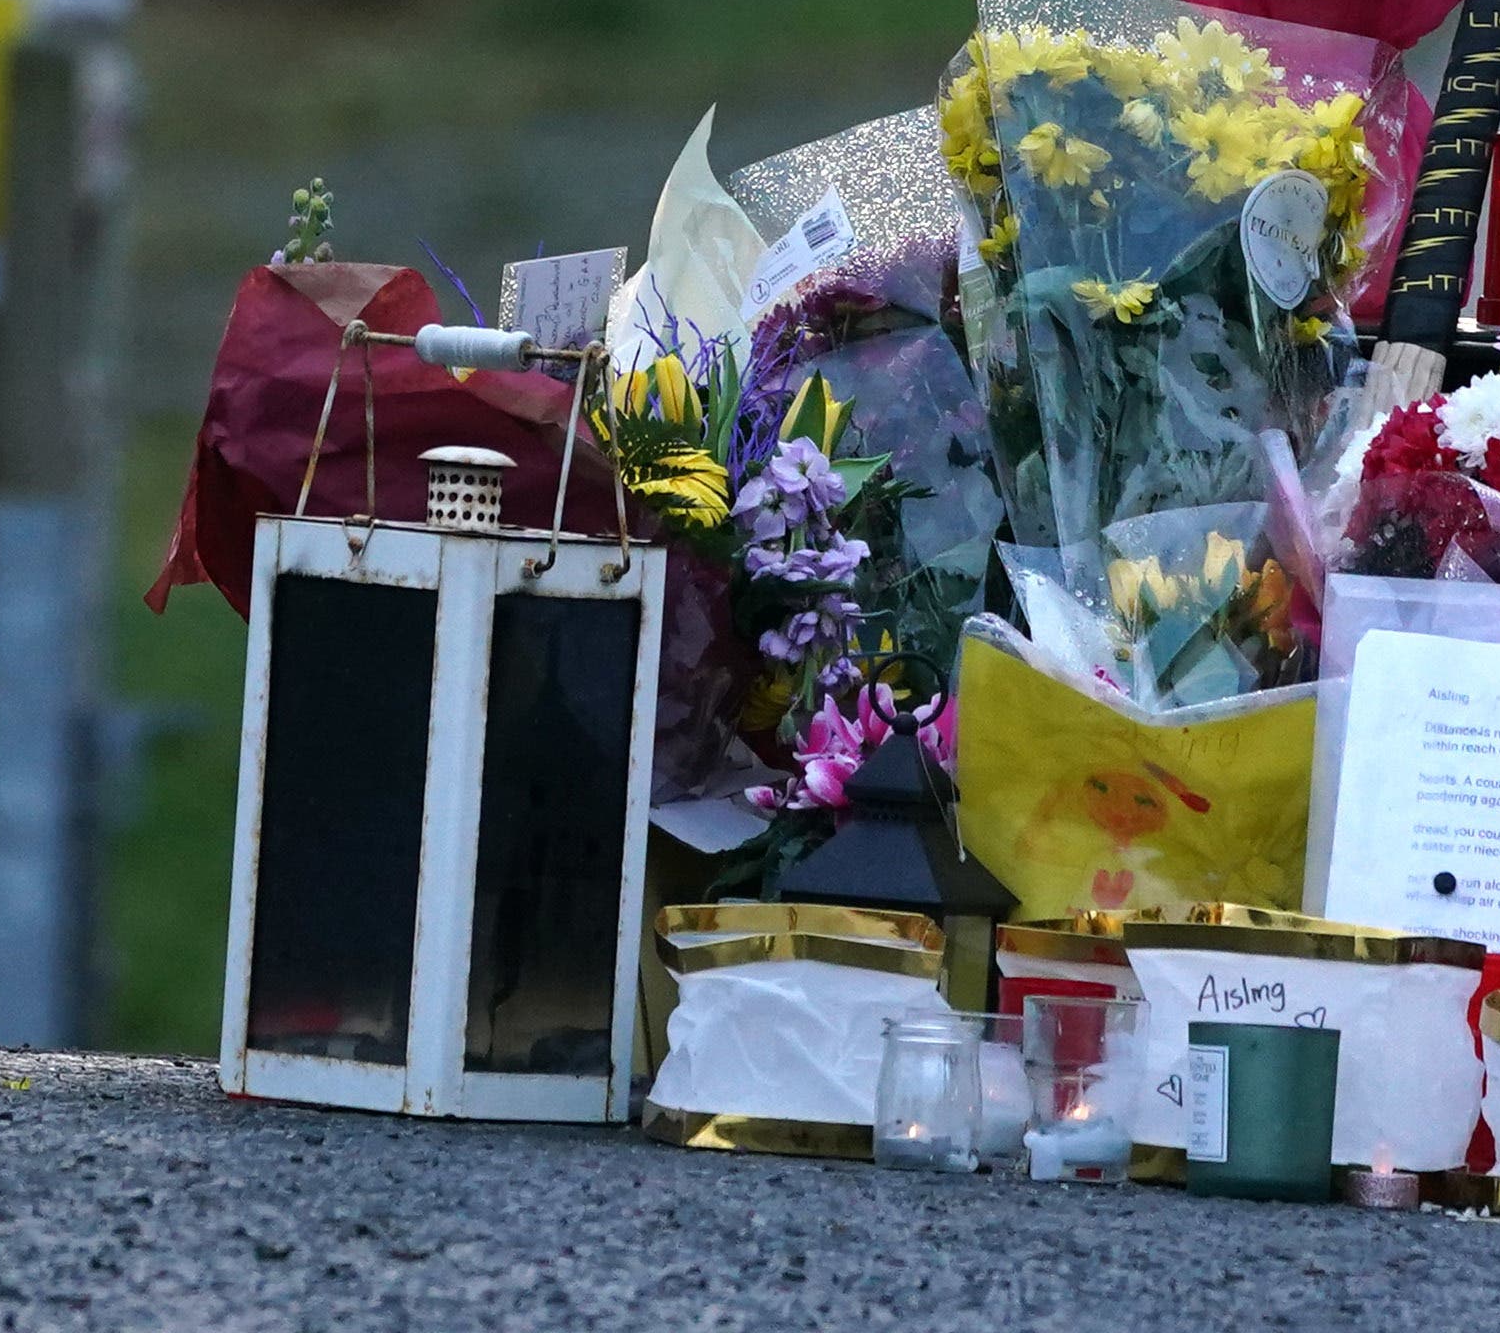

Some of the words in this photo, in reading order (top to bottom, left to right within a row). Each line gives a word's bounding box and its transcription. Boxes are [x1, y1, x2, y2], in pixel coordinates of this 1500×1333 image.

[1428, 688, 1470, 706] Aisling
[1423, 740, 1459, 751] within
[1461, 742, 1496, 754] reach
[1464, 775, 1472, 787] A
[1454, 827, 1475, 839] you
[1458, 844, 1471, 853] or
[1461, 878, 1480, 889] run
[1478, 896, 1494, 907] air
